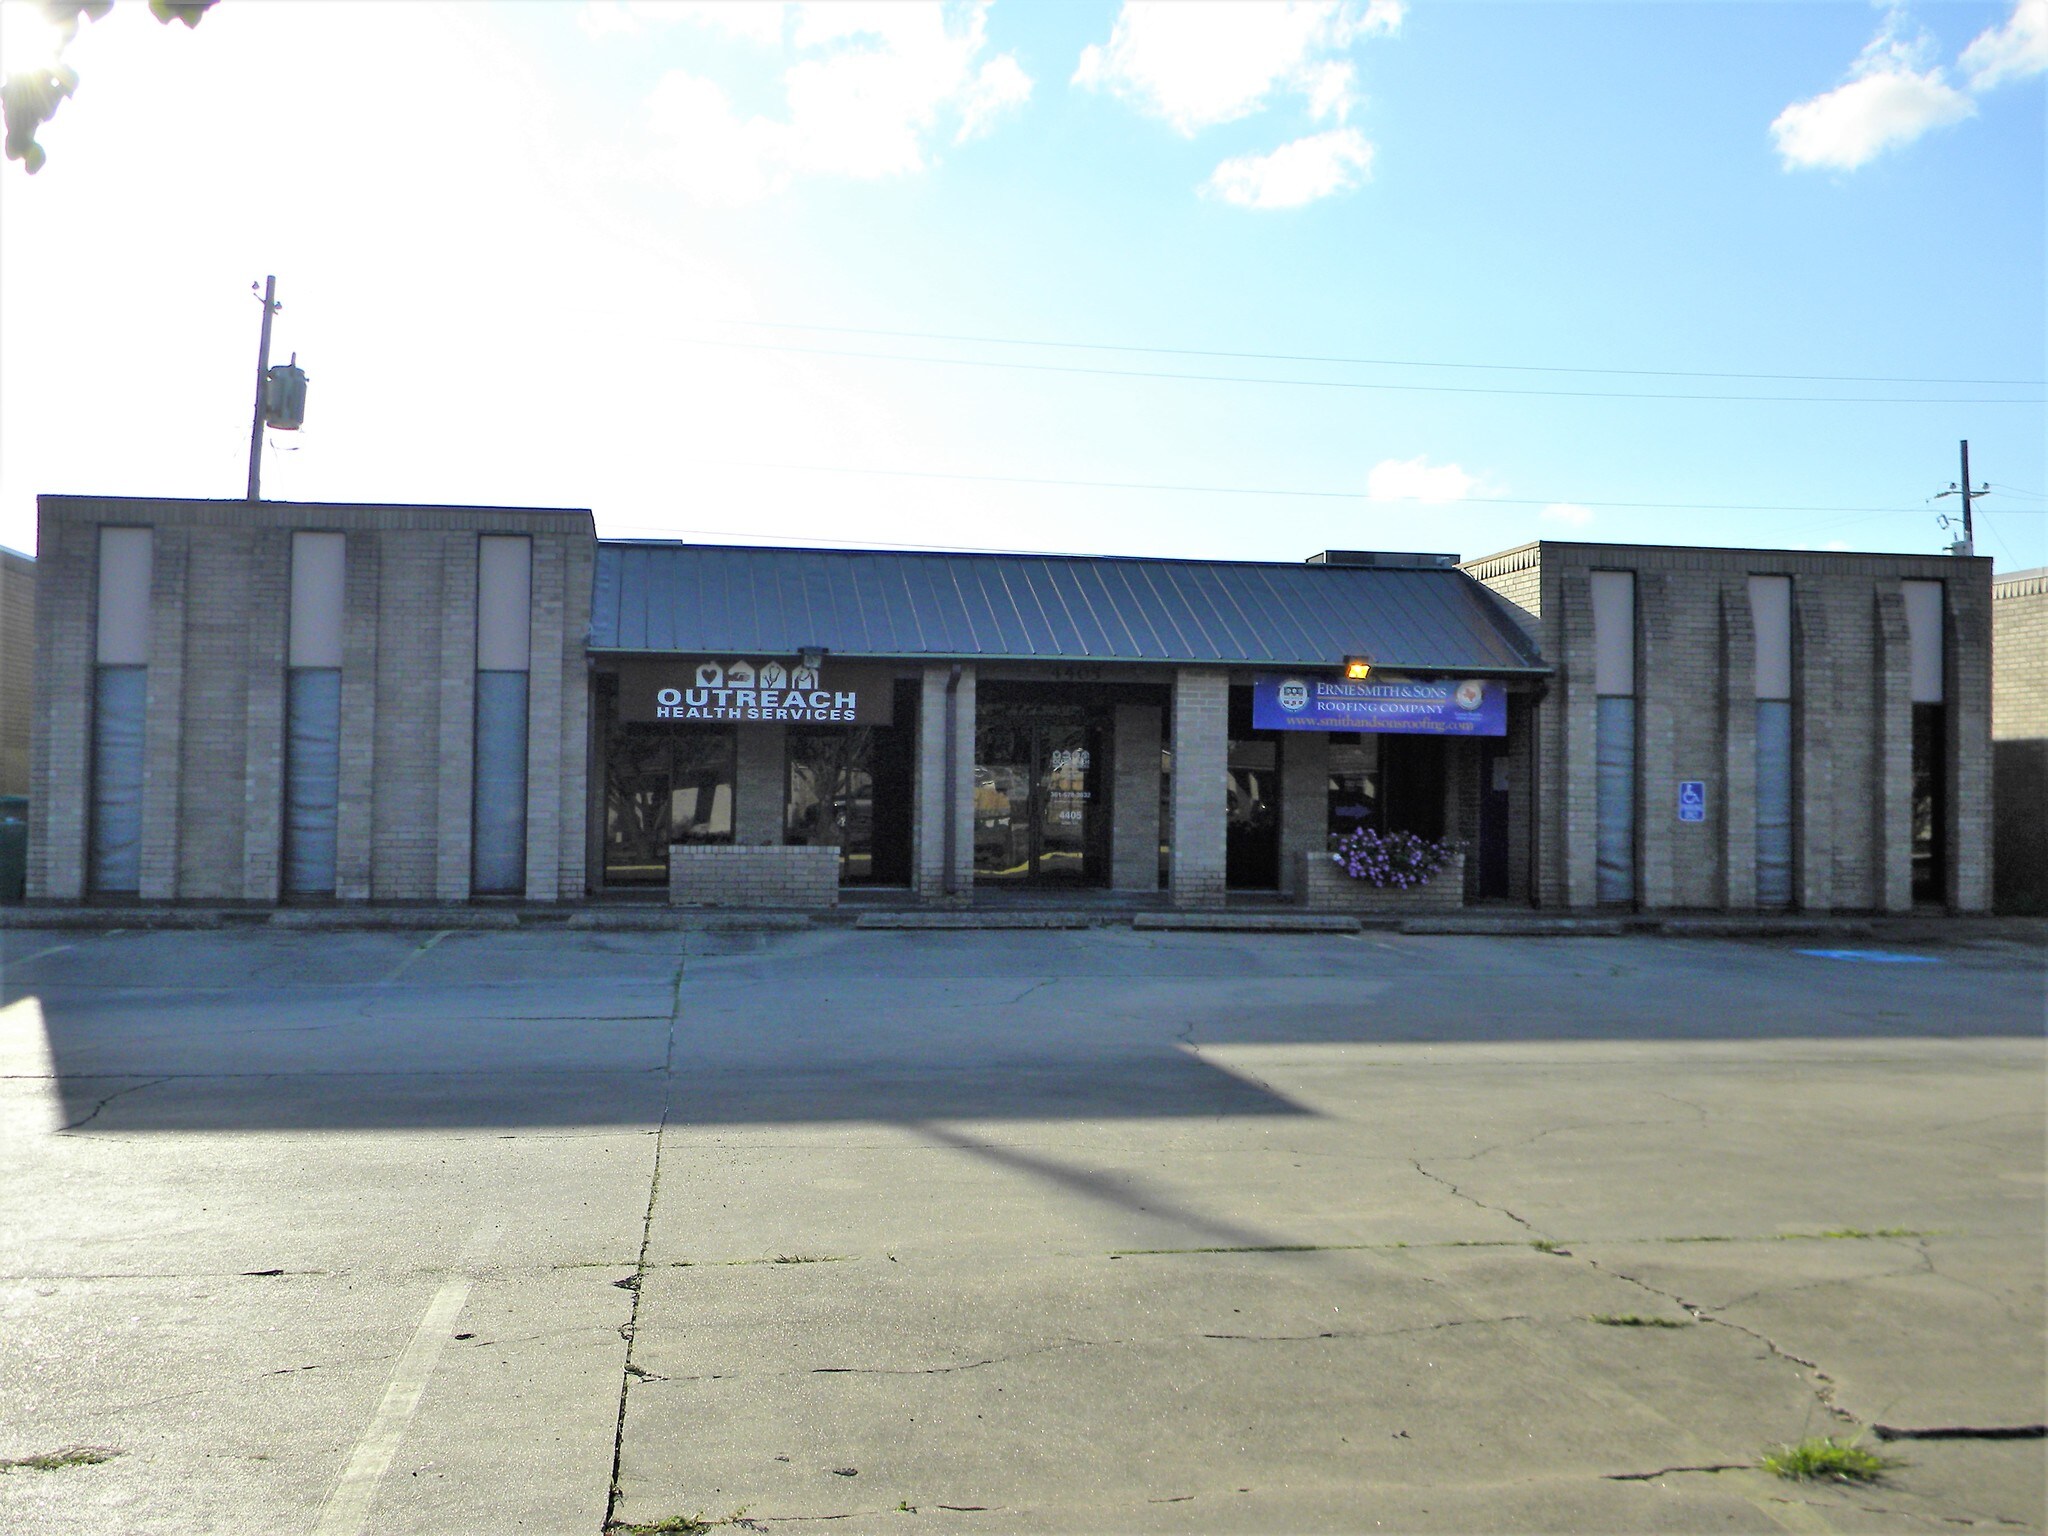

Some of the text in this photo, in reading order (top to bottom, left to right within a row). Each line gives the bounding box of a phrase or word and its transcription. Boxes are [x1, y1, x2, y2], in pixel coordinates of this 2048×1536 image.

[1317, 682, 1447, 698] ERNIE SMITH & SONS
[657, 688, 856, 709] OUTREACH
[656, 706, 856, 721] HEALTH SERVICES
[1317, 701, 1377, 712] ROOFING
[1380, 703, 1445, 714] COMPANY
[1286, 714, 1474, 732] www.smithandsonsroofing.com
[1059, 810, 1082, 820] 4405
